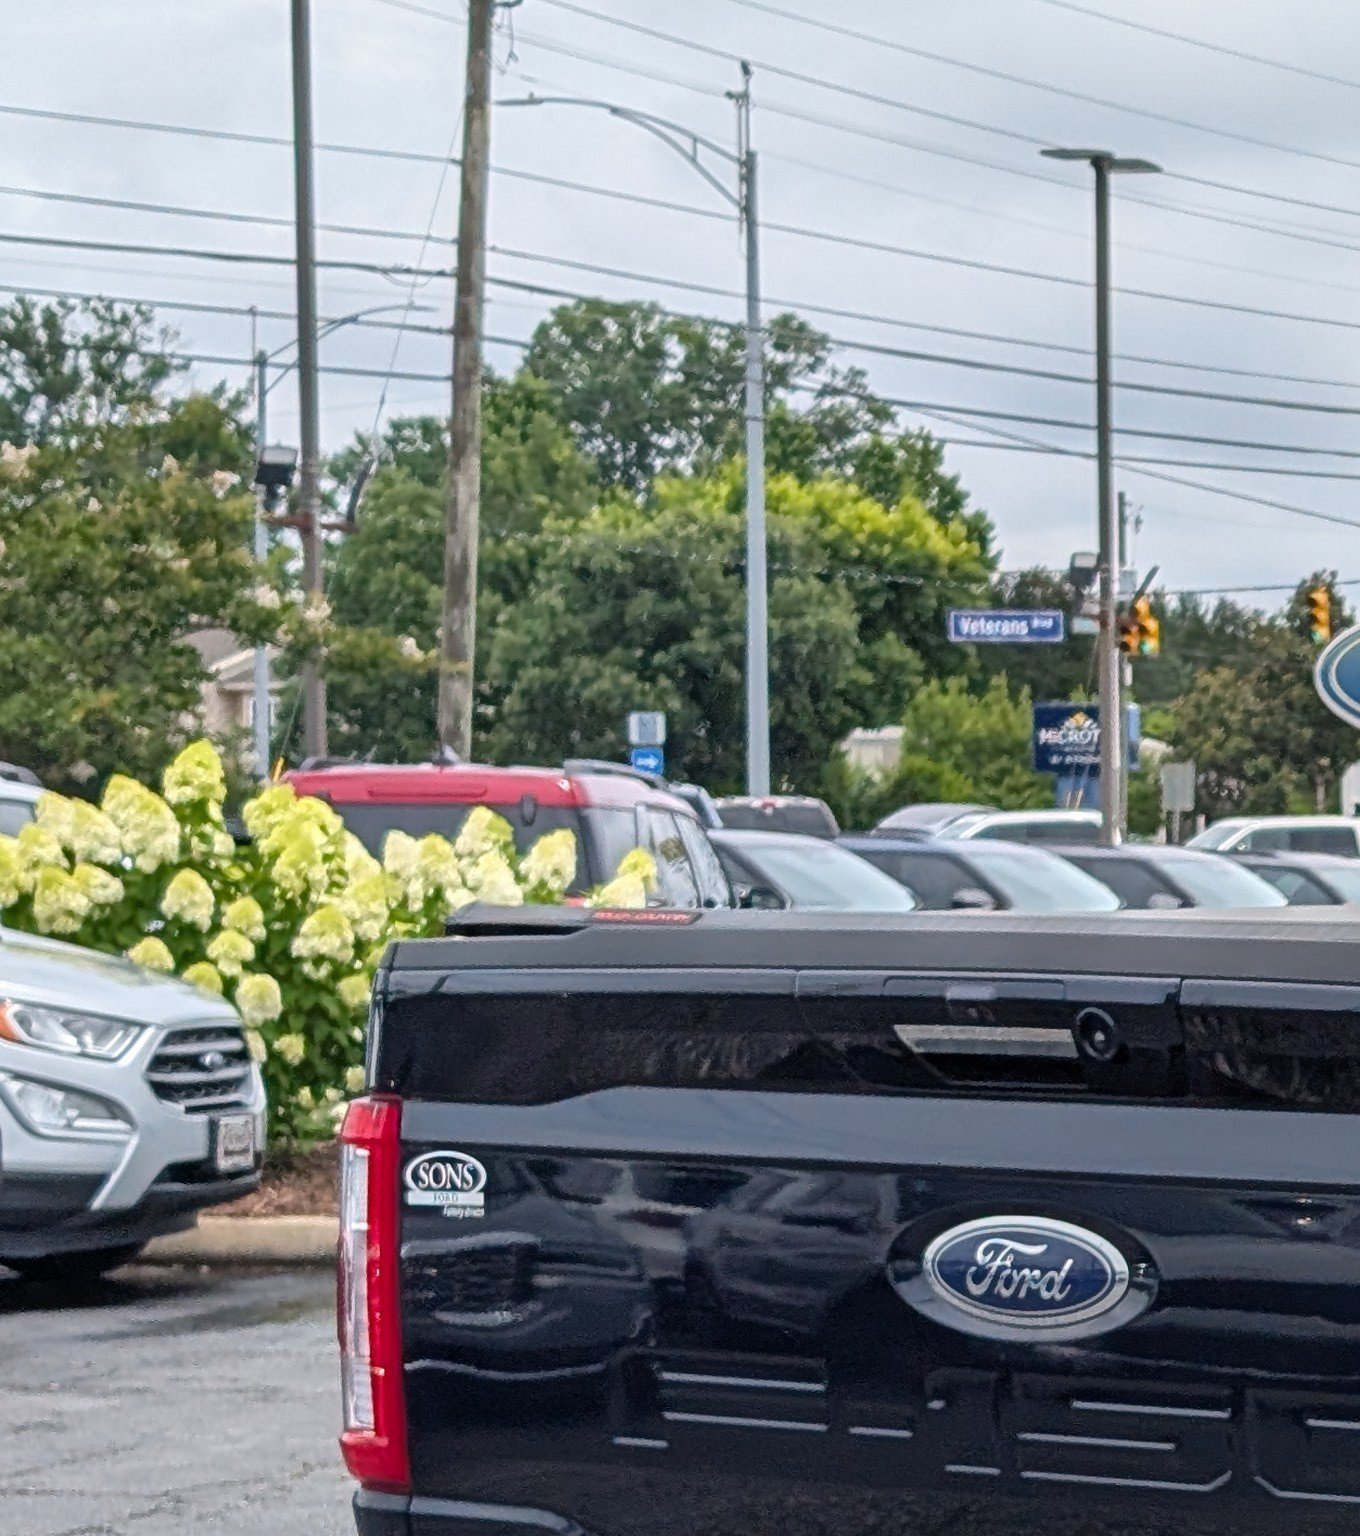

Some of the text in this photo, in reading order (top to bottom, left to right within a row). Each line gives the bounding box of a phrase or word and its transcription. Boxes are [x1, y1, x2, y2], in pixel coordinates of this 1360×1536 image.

[959, 616, 1028, 635] Veterans
[418, 1161, 474, 1190] SONS
[433, 1192, 460, 1203] FORD
[965, 1237, 1074, 1302] Ford
